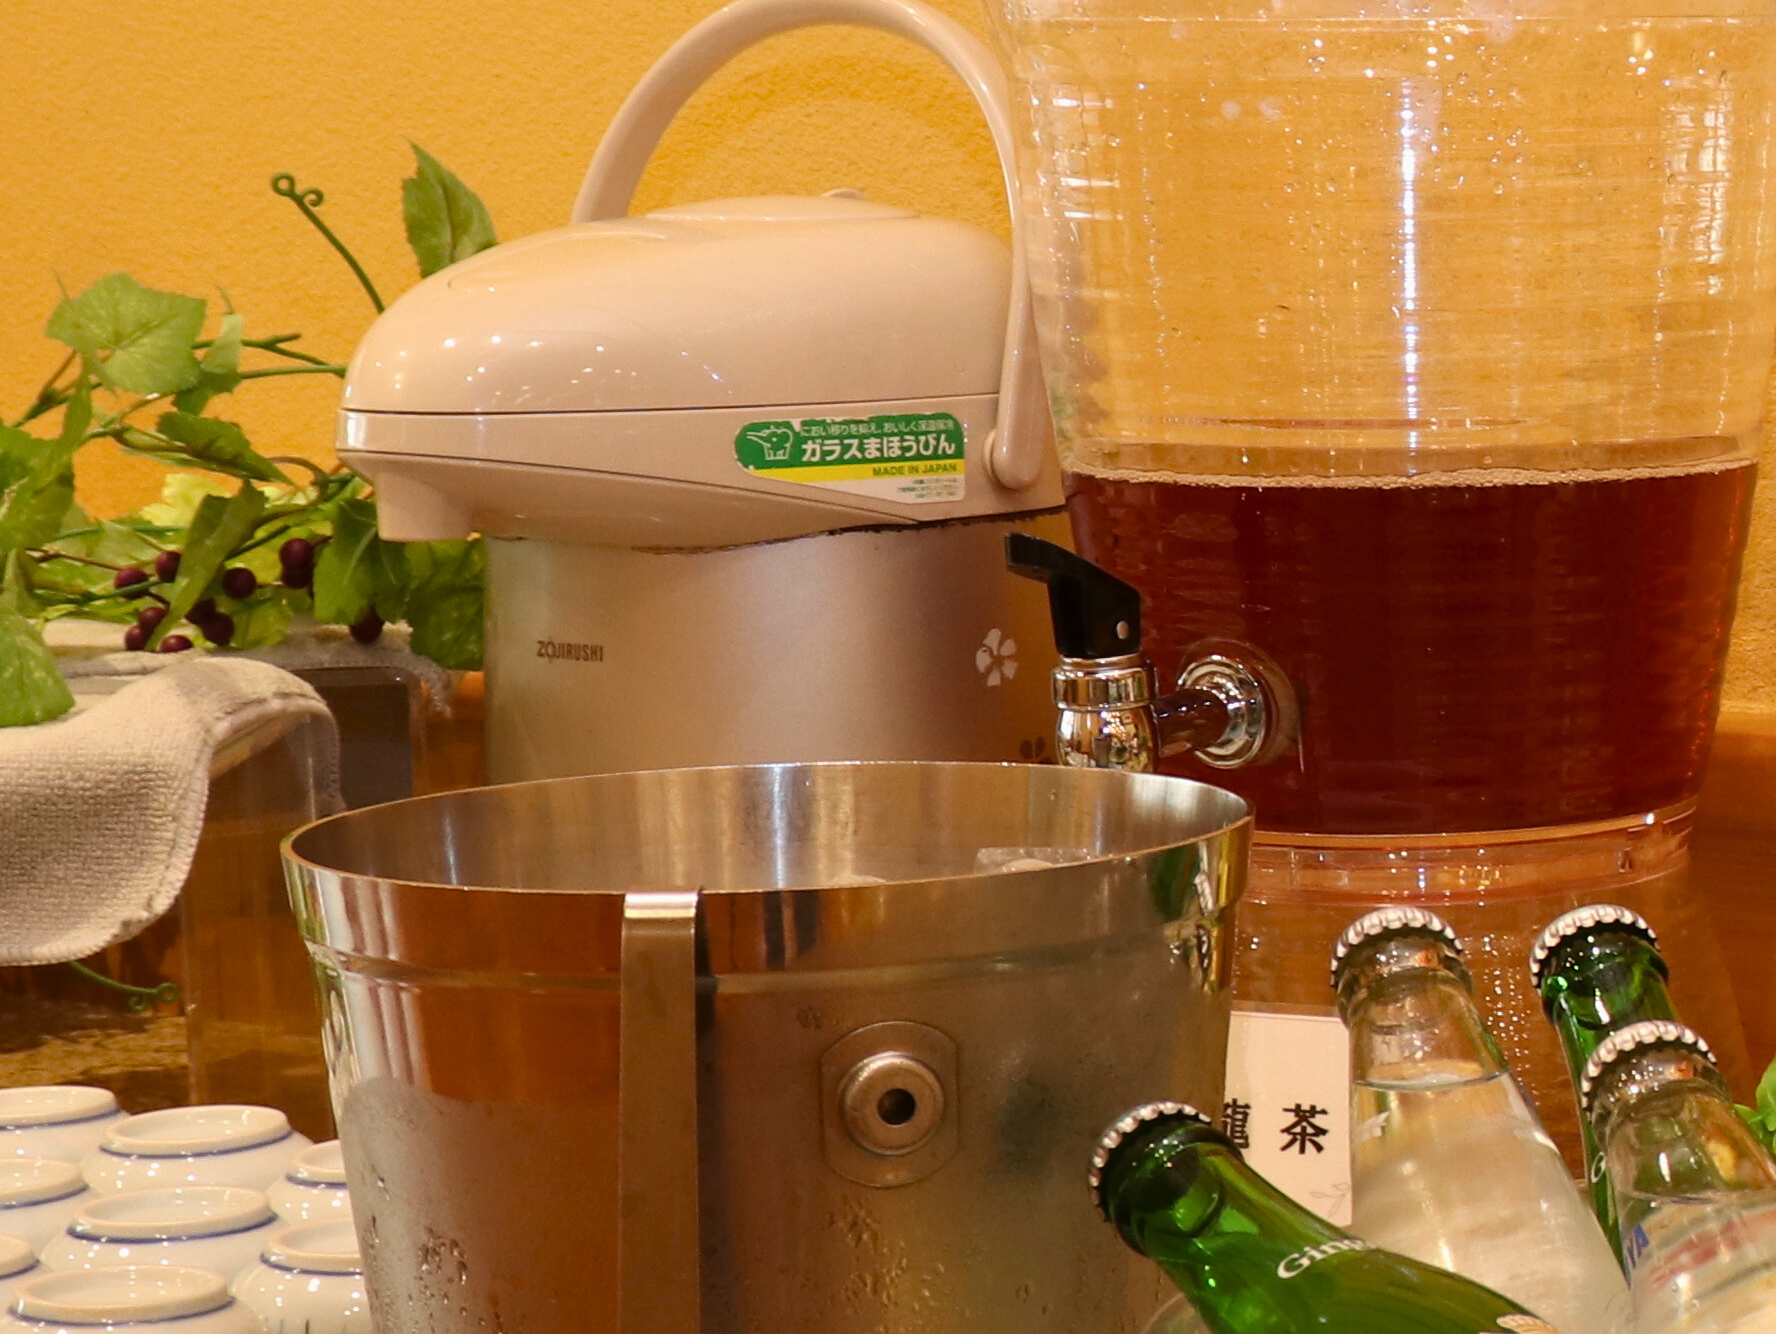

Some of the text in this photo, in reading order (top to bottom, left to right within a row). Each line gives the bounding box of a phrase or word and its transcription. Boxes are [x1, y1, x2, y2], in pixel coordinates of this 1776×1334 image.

[800, 433, 956, 462] ガラスまほうびん
[872, 463, 957, 478] MADE IN JAPAN
